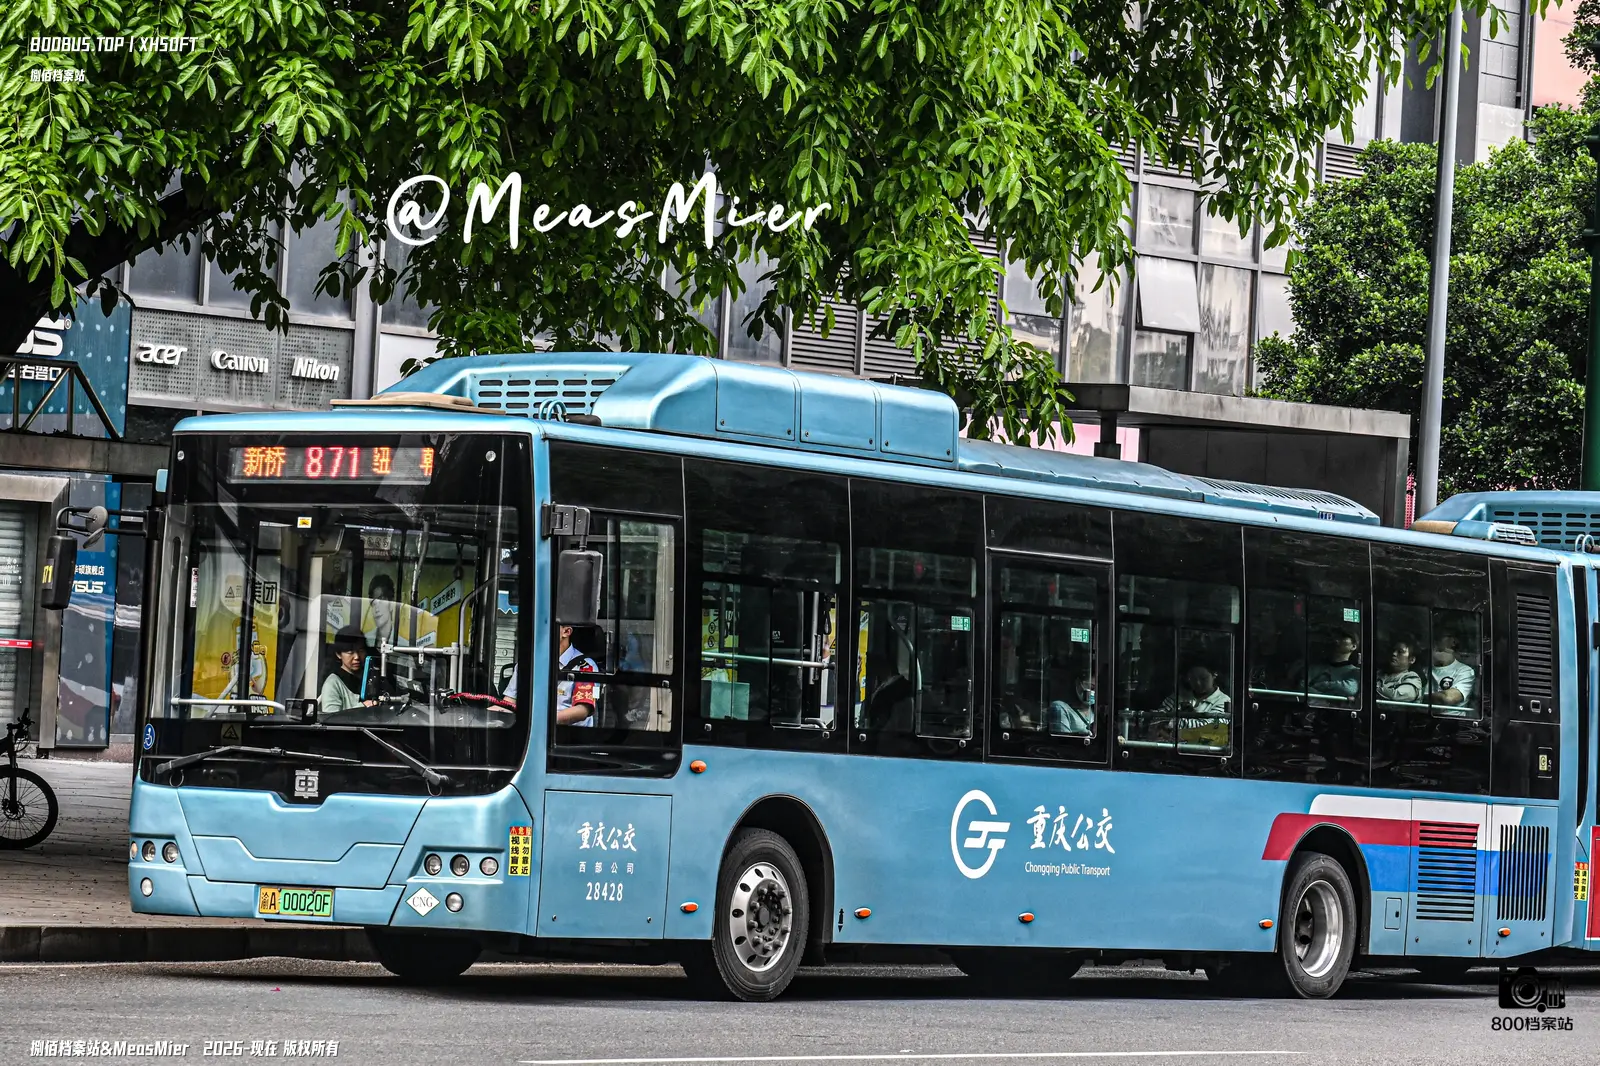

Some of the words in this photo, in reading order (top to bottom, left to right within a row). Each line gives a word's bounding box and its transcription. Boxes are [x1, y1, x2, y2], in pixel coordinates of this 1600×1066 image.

[136, 342, 188, 366] acer
[210, 350, 269, 374] Canon
[291, 357, 341, 381] Nikon
[243, 446, 286, 477] 新桥
[305, 446, 361, 478] 871
[576, 821, 637, 852] 重庆公交
[1026, 804, 1116, 854] 重庆公交
[578, 861, 634, 875] 西部公司
[1024, 861, 1060, 877] Chongqing
[1061, 862, 1080, 876] Public
[1081, 863, 1111, 878] Transport
[412, 896, 433, 907] CNG
[585, 882, 624, 901] 28428
